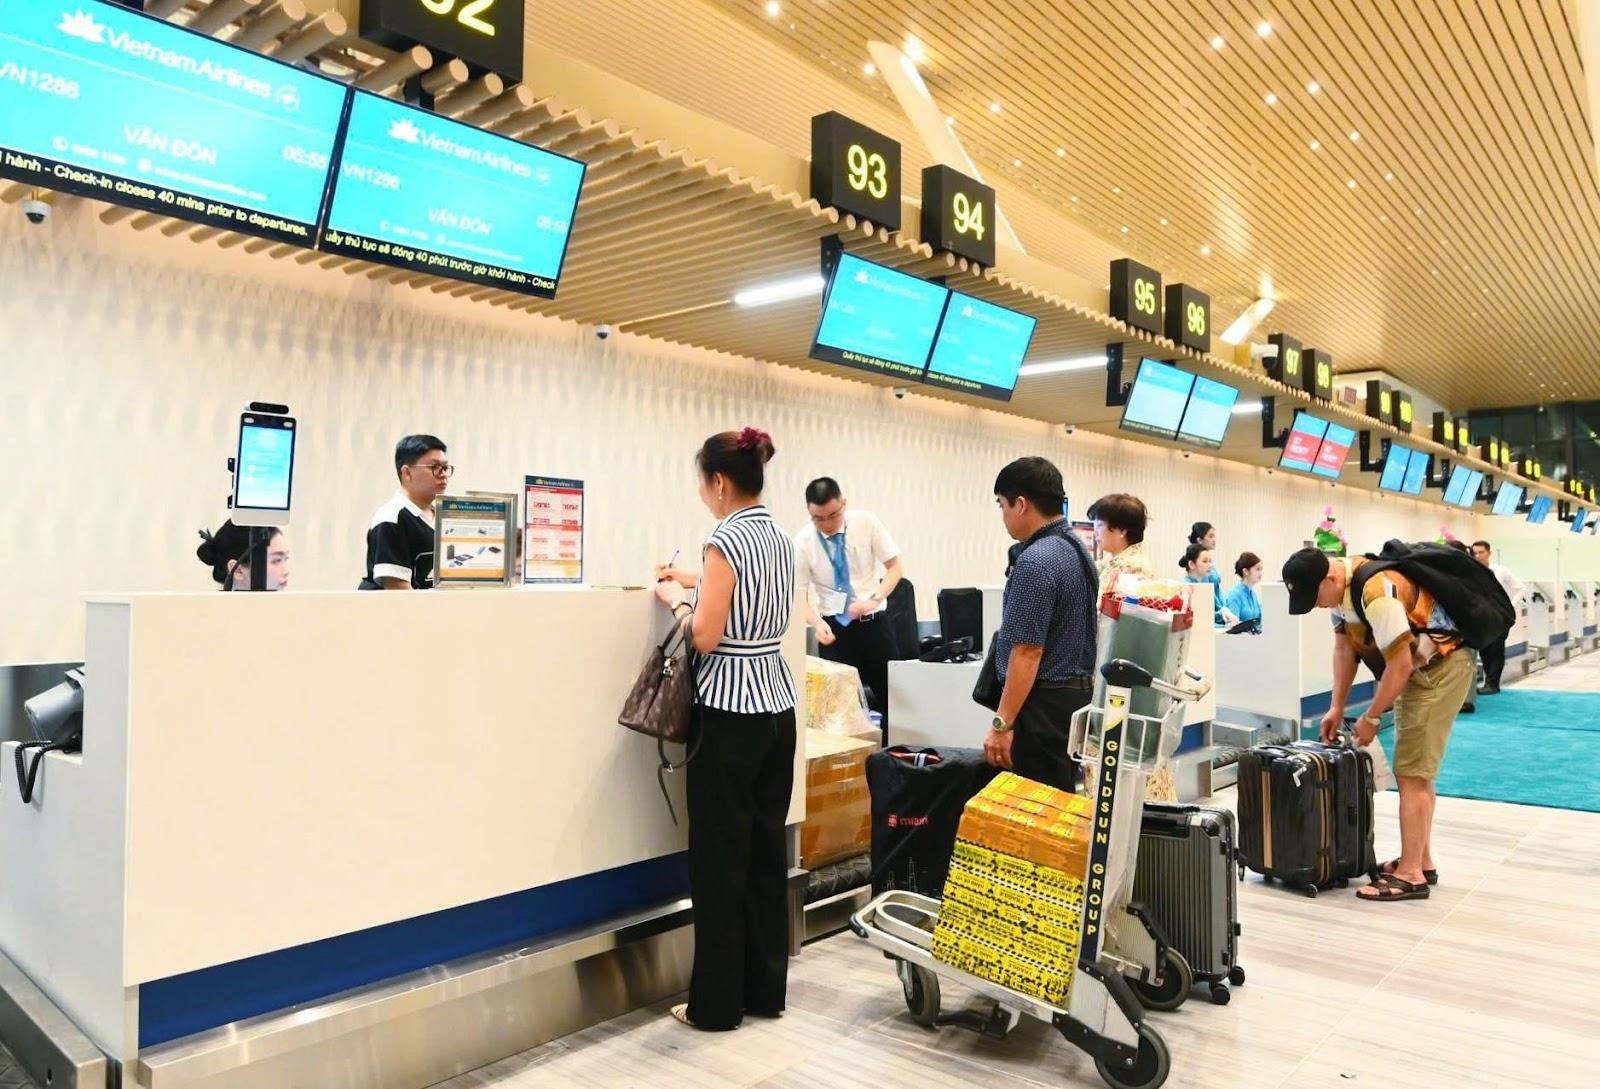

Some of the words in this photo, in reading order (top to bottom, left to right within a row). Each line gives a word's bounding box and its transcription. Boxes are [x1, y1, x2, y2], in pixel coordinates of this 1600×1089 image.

[421, 0, 496, 37] 2
[6, 152, 41, 172] hành
[54, 164, 112, 189] Check-in
[115, 180, 156, 199] closes
[158, 189, 174, 204] 40
[177, 196, 205, 212] mins
[207, 203, 234, 218] prior
[236, 209, 247, 221] to
[249, 213, 308, 236] departures.
[847, 144, 887, 199] 93
[953, 192, 985, 241] 94
[416, 251, 428, 262] 40
[1134, 278, 1156, 315] 95
[1187, 302, 1205, 336] 96
[1096, 740, 1118, 845] GOLDSUN
[1087, 862, 1104, 935] GROUP
